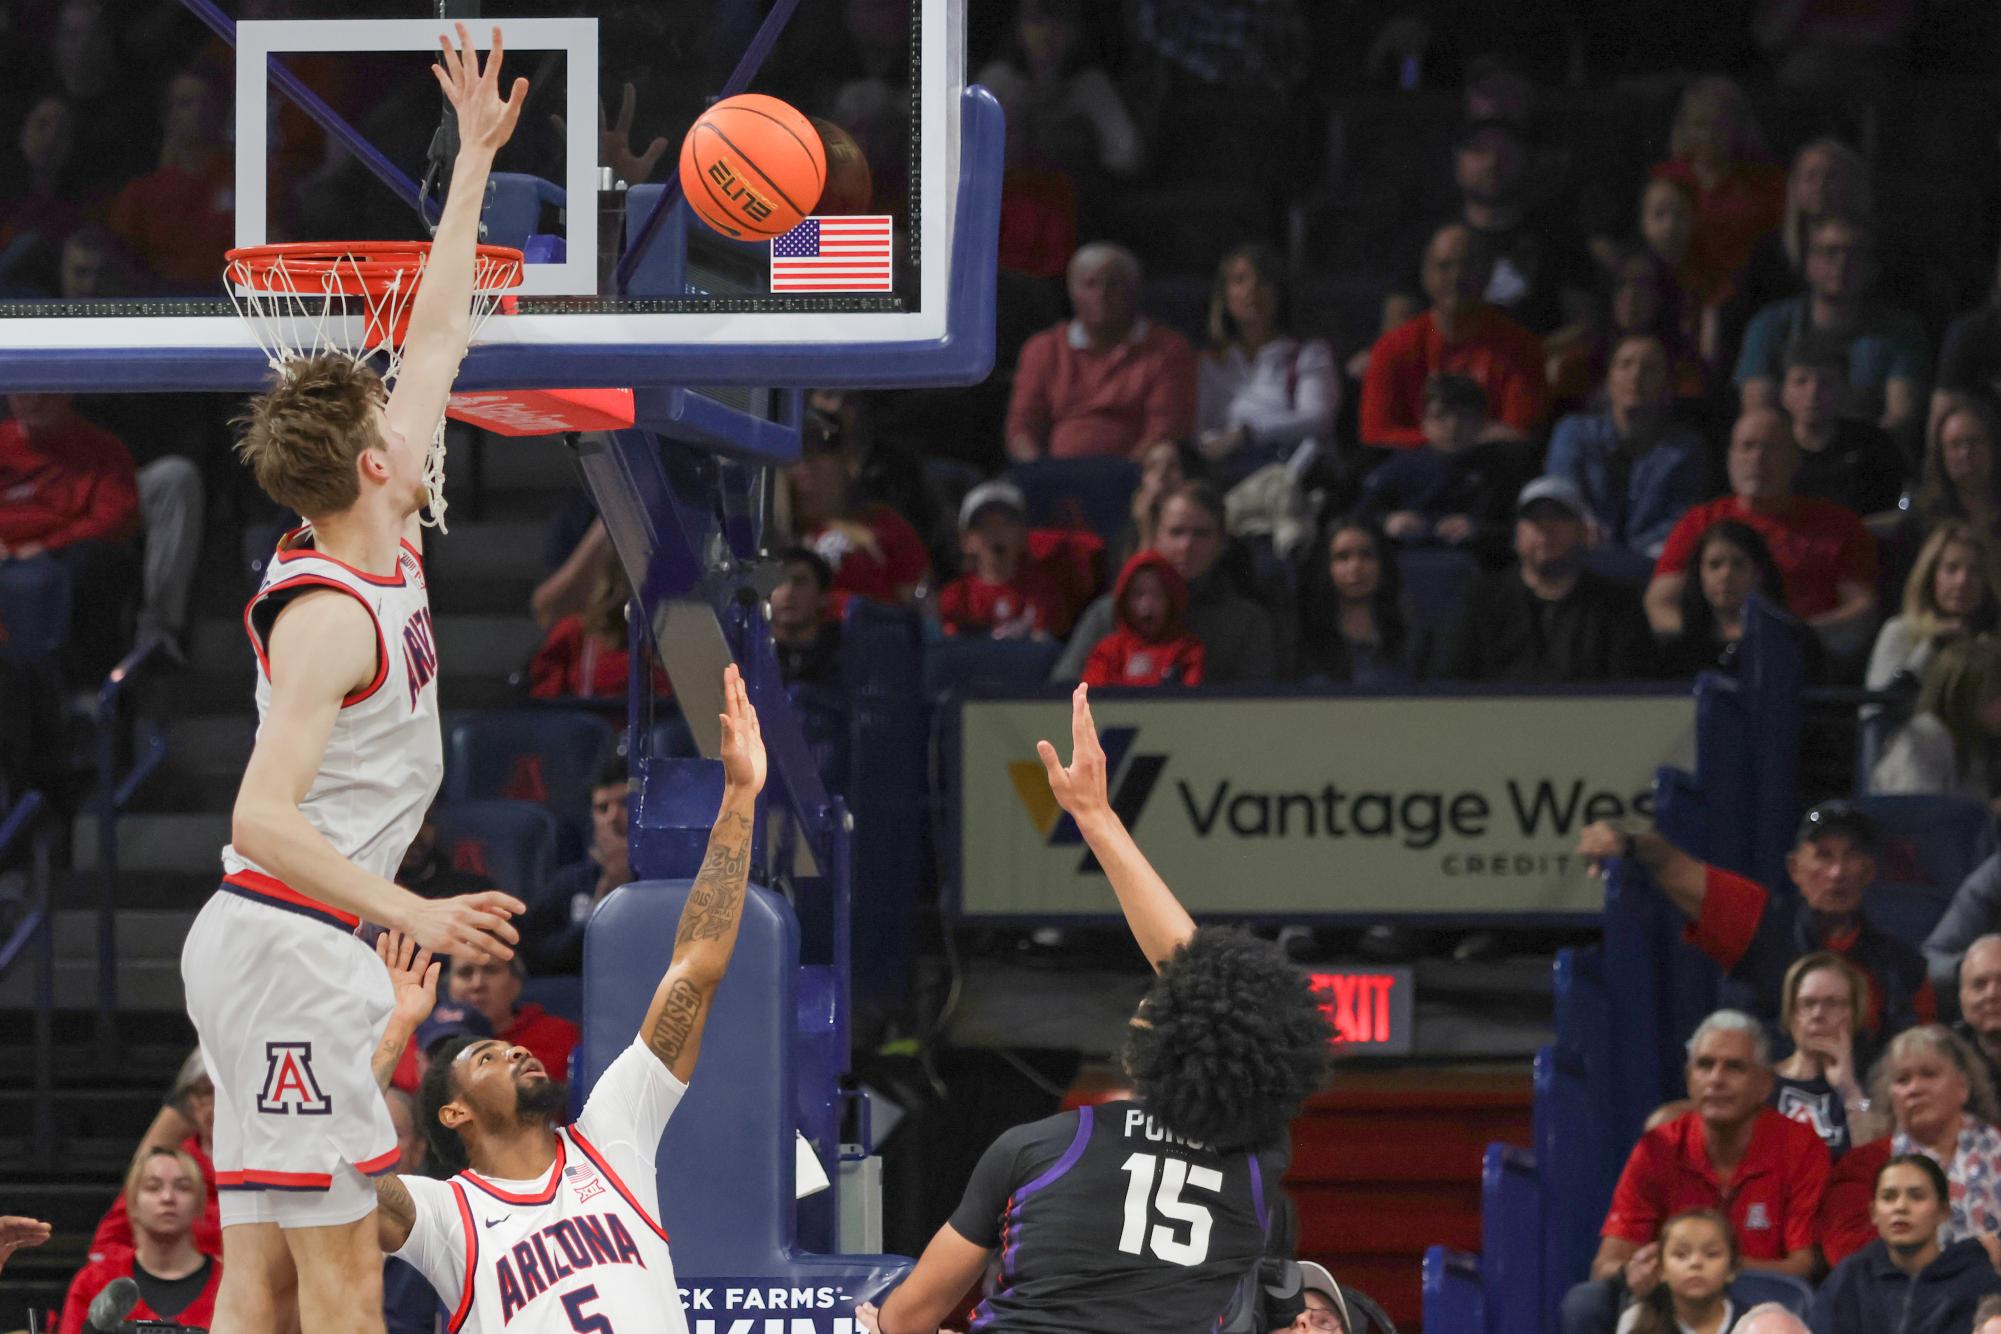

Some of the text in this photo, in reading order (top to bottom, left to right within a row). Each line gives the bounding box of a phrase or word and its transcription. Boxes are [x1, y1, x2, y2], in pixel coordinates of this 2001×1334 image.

[707, 160, 773, 222] ELITE
[1176, 779, 1490, 849] Vantage
[1441, 854, 1570, 877] CREDIT
[652, 978, 703, 1060] CHASER
[256, 1042, 332, 1115] A
[1118, 1152, 1223, 1267] 15
[495, 1212, 648, 1328] ARIZONA
[559, 1283, 615, 1334] 5
